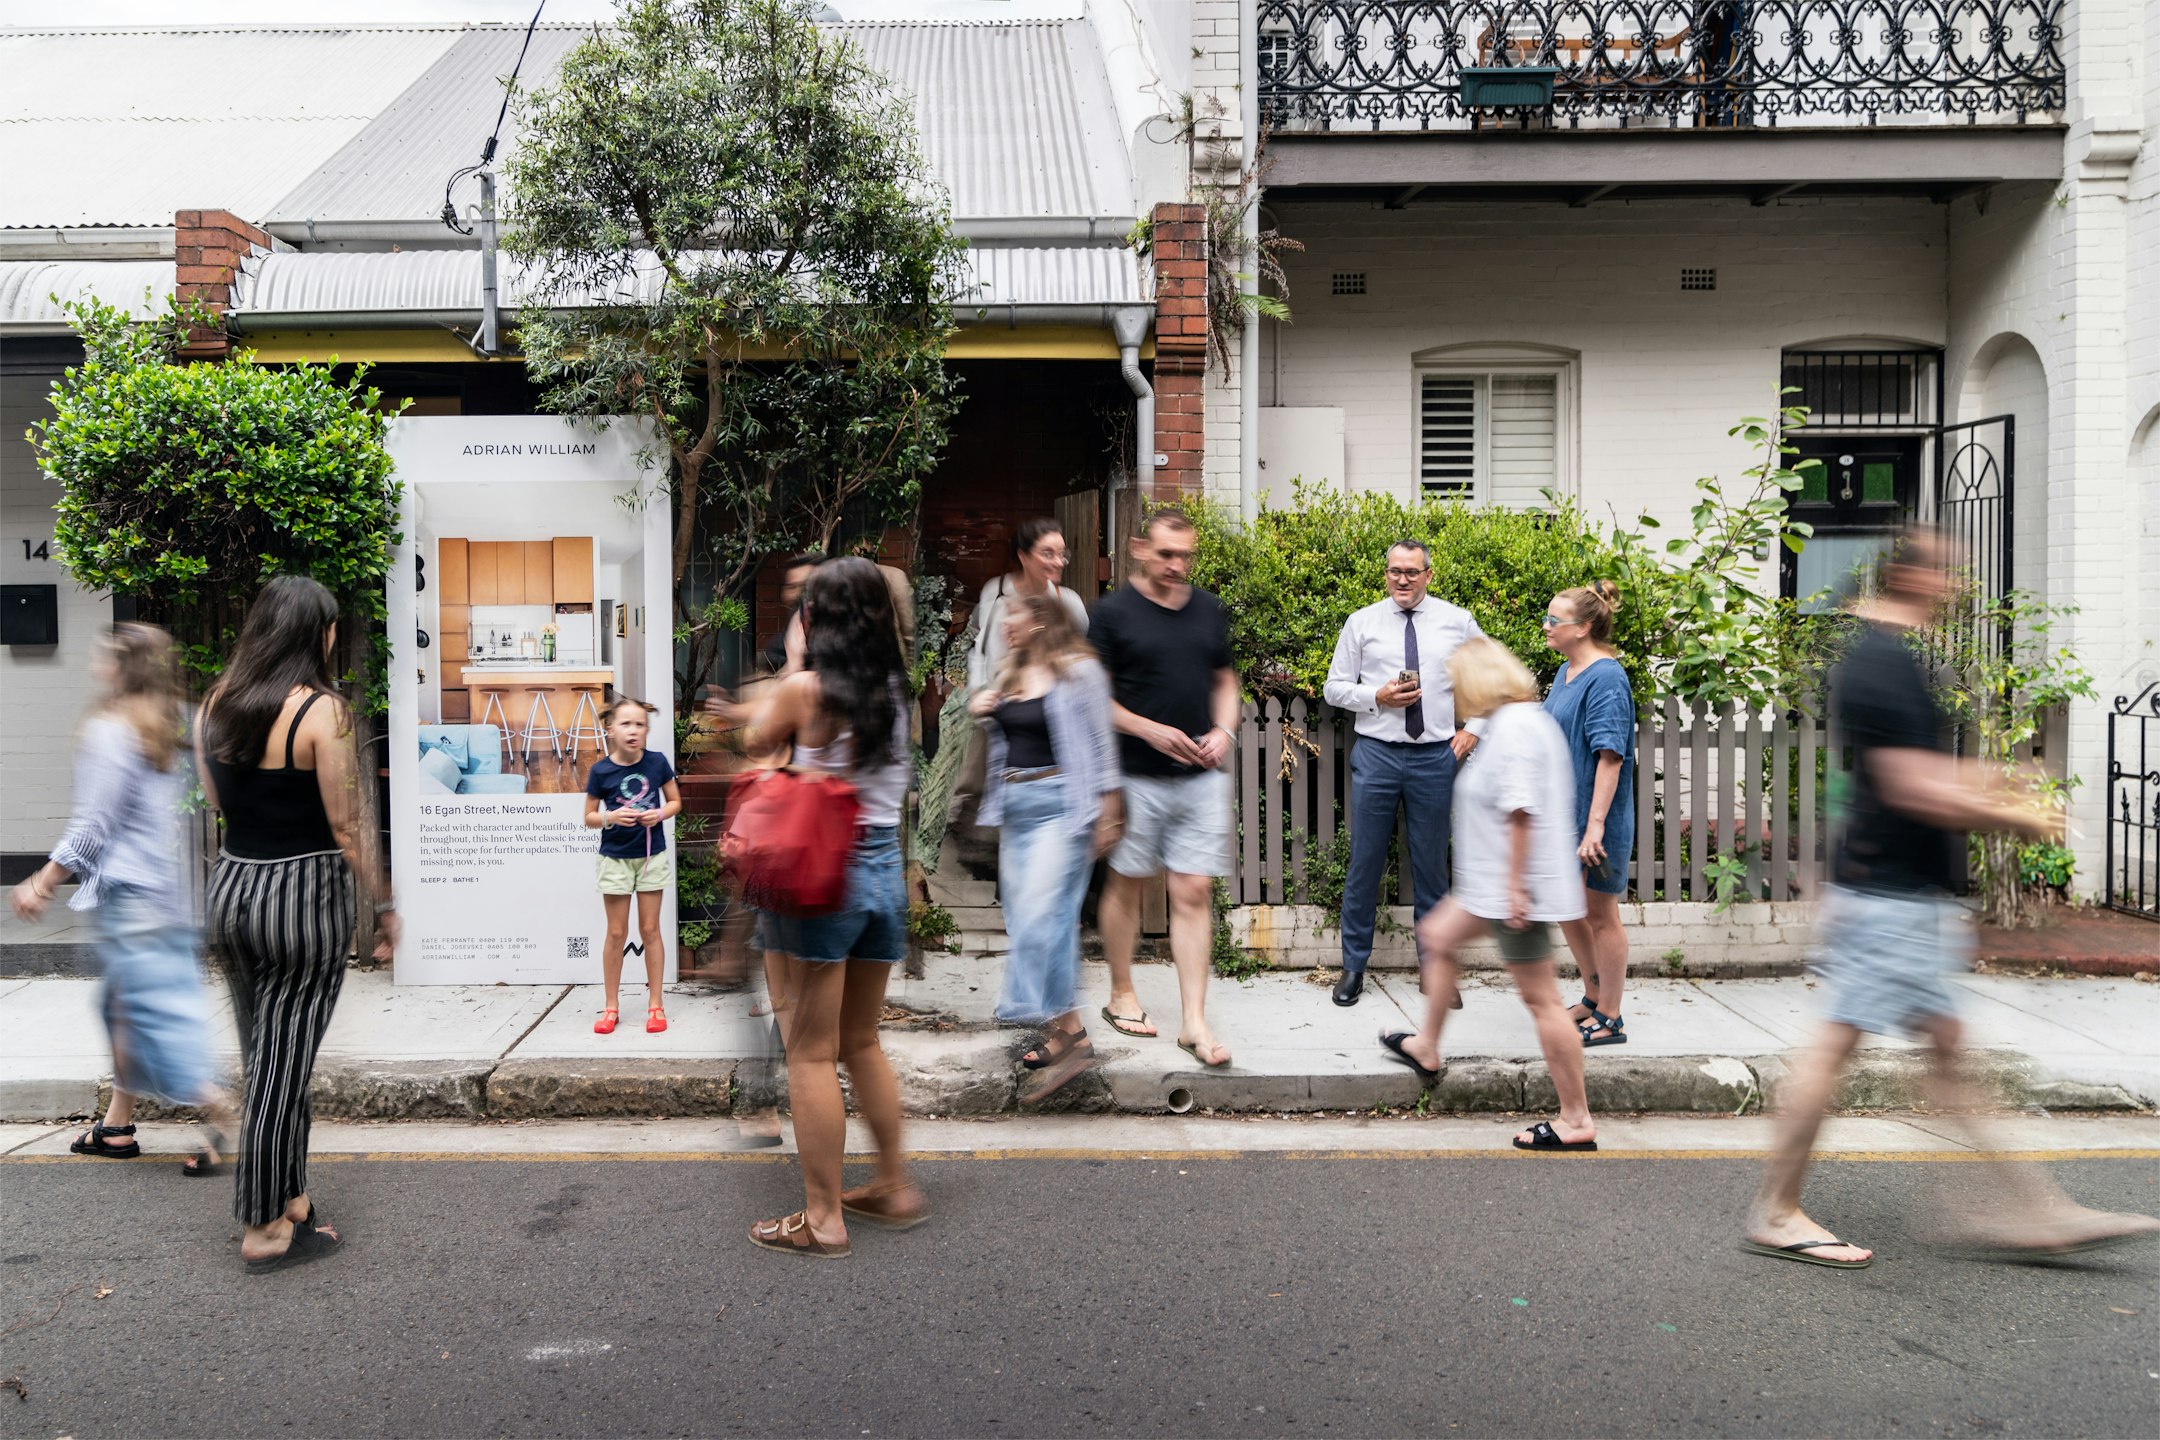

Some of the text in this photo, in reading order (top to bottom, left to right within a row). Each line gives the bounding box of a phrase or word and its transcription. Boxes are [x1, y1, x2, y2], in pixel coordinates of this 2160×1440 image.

[462, 444, 597, 456] ADRIAN WILLIAM
[22, 539, 50, 561] 14
[419, 804, 552, 817] 16 Egan Street, Newtown
[420, 823, 450, 833] Packed
[452, 823, 472, 832] with
[473, 823, 513, 832] character
[514, 822, 531, 832] and
[532, 822, 578, 833] beautifully
[420, 833, 601, 846] throughout, this Inner West classic is ready
[420, 844, 600, 857] in, with scope for further updates. The only
[420, 857, 505, 868] missing now, is you.
